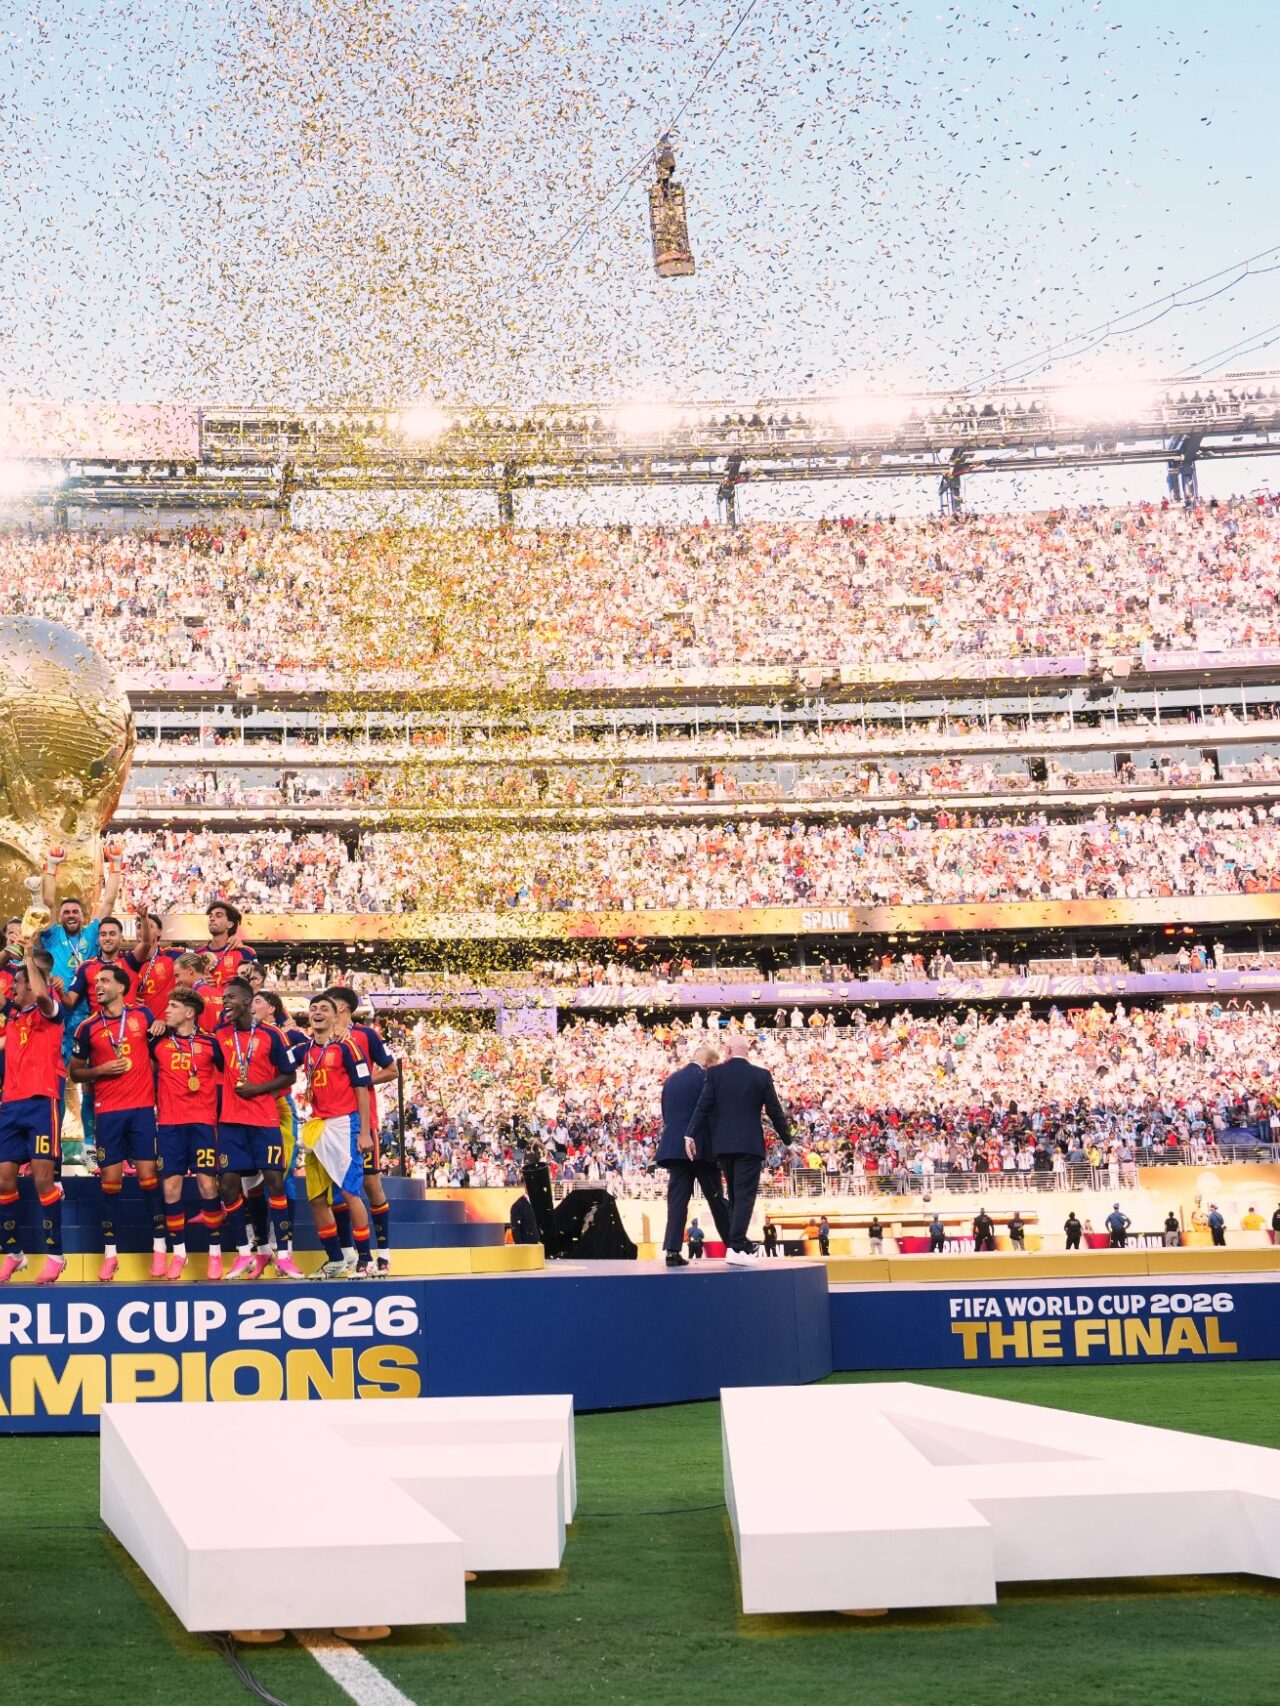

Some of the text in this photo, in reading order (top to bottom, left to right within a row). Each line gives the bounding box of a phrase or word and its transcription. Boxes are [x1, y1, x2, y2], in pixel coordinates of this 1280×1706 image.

[802, 911, 849, 929] SPAIN
[170, 1052, 191, 1071] 25
[35, 1134, 50, 1154] 16
[196, 1149, 216, 1168] 25
[267, 1145, 282, 1165] 17
[949, 1292, 1235, 1319] FIFA WORLD CUP 2026
[117, 1300, 227, 1342] CUP
[237, 1295, 420, 1340] 2026
[950, 1316, 1238, 1360] THE FINAL
